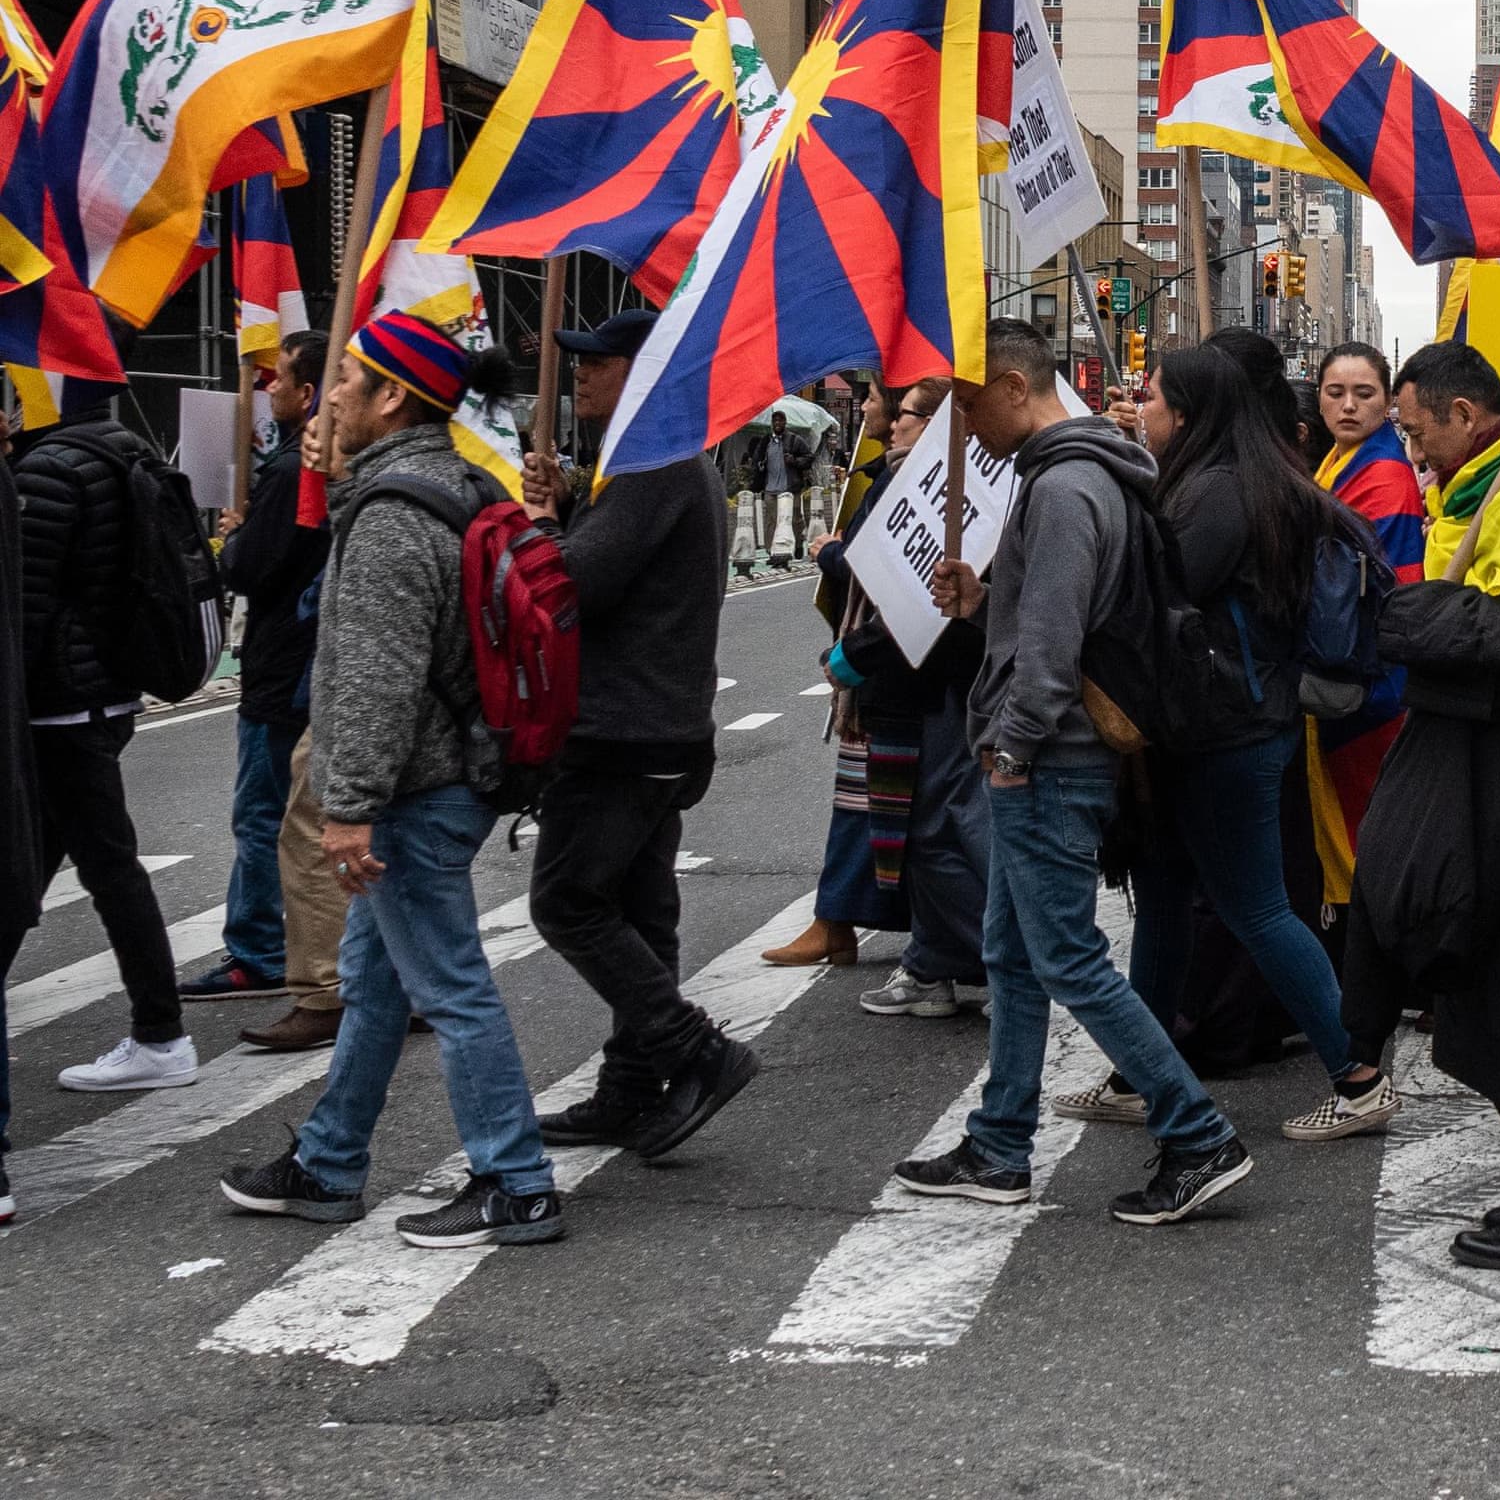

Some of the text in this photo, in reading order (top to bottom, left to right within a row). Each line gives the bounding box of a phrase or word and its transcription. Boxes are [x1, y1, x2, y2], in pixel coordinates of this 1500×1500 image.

[1020, 98, 1052, 150] Tibet
[1051, 145, 1077, 187] Tibet
[918, 459, 980, 534] A PT
[886, 497, 945, 590] OF CHI
